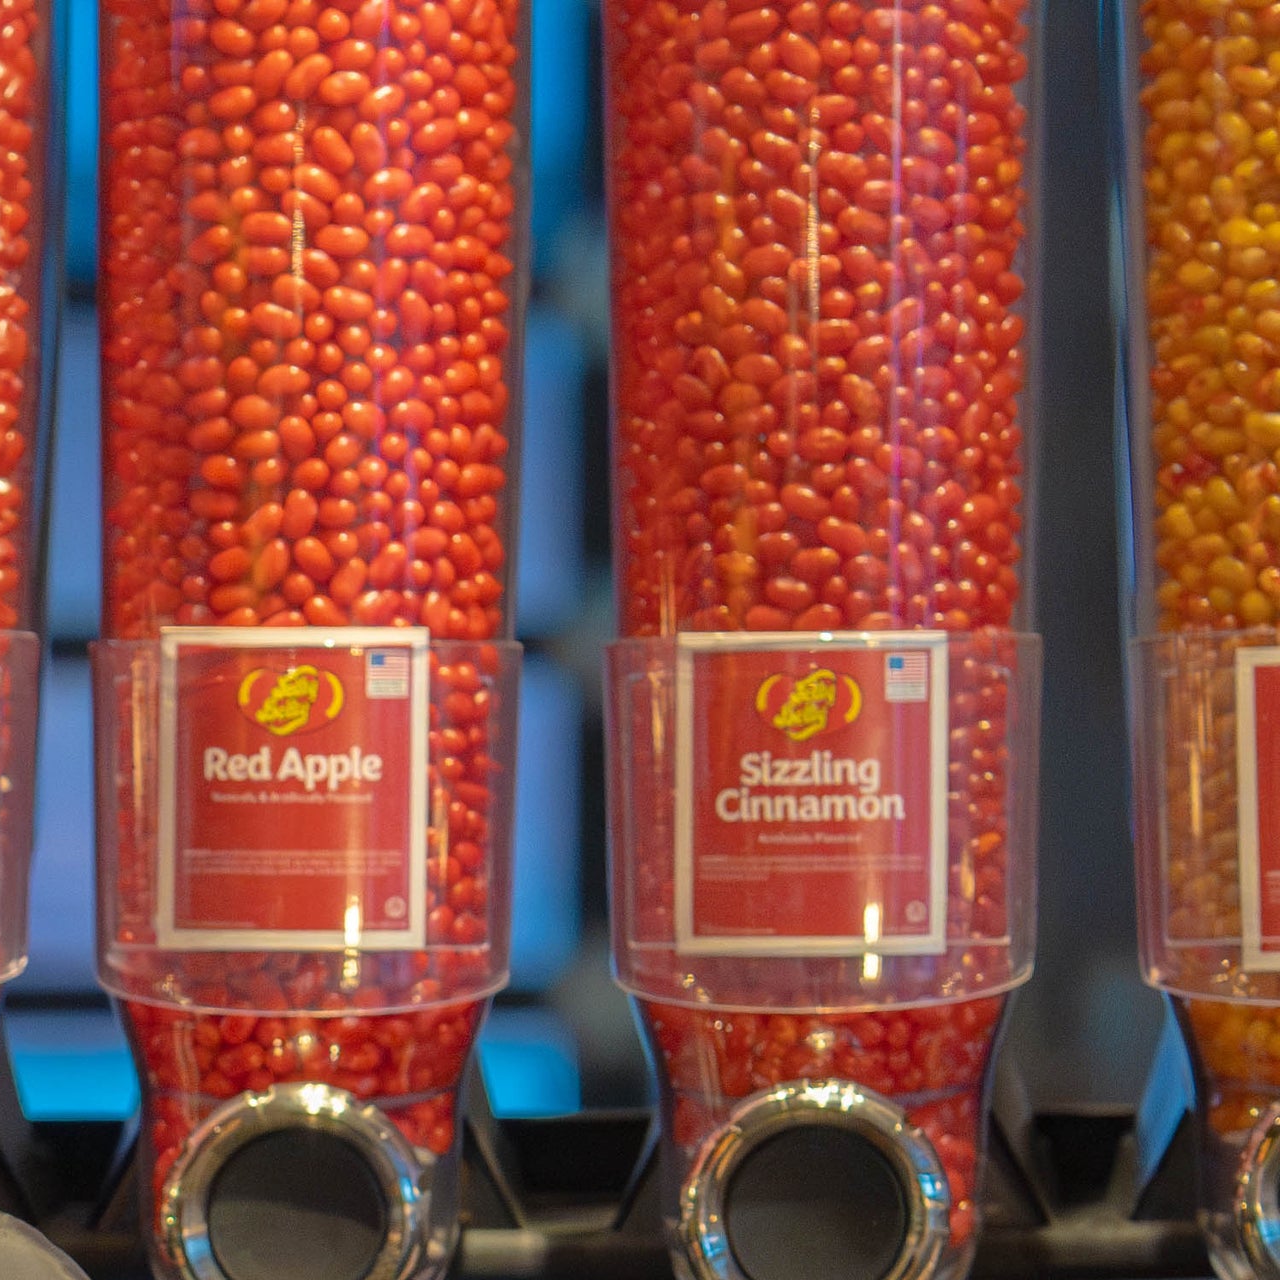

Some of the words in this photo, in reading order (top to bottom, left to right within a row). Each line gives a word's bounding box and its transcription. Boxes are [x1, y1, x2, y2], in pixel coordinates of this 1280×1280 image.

[203, 746, 271, 781] Red
[277, 746, 382, 791] Apple
[740, 750, 880, 793] Sizzling
[715, 788, 906, 823] Cinnamon
